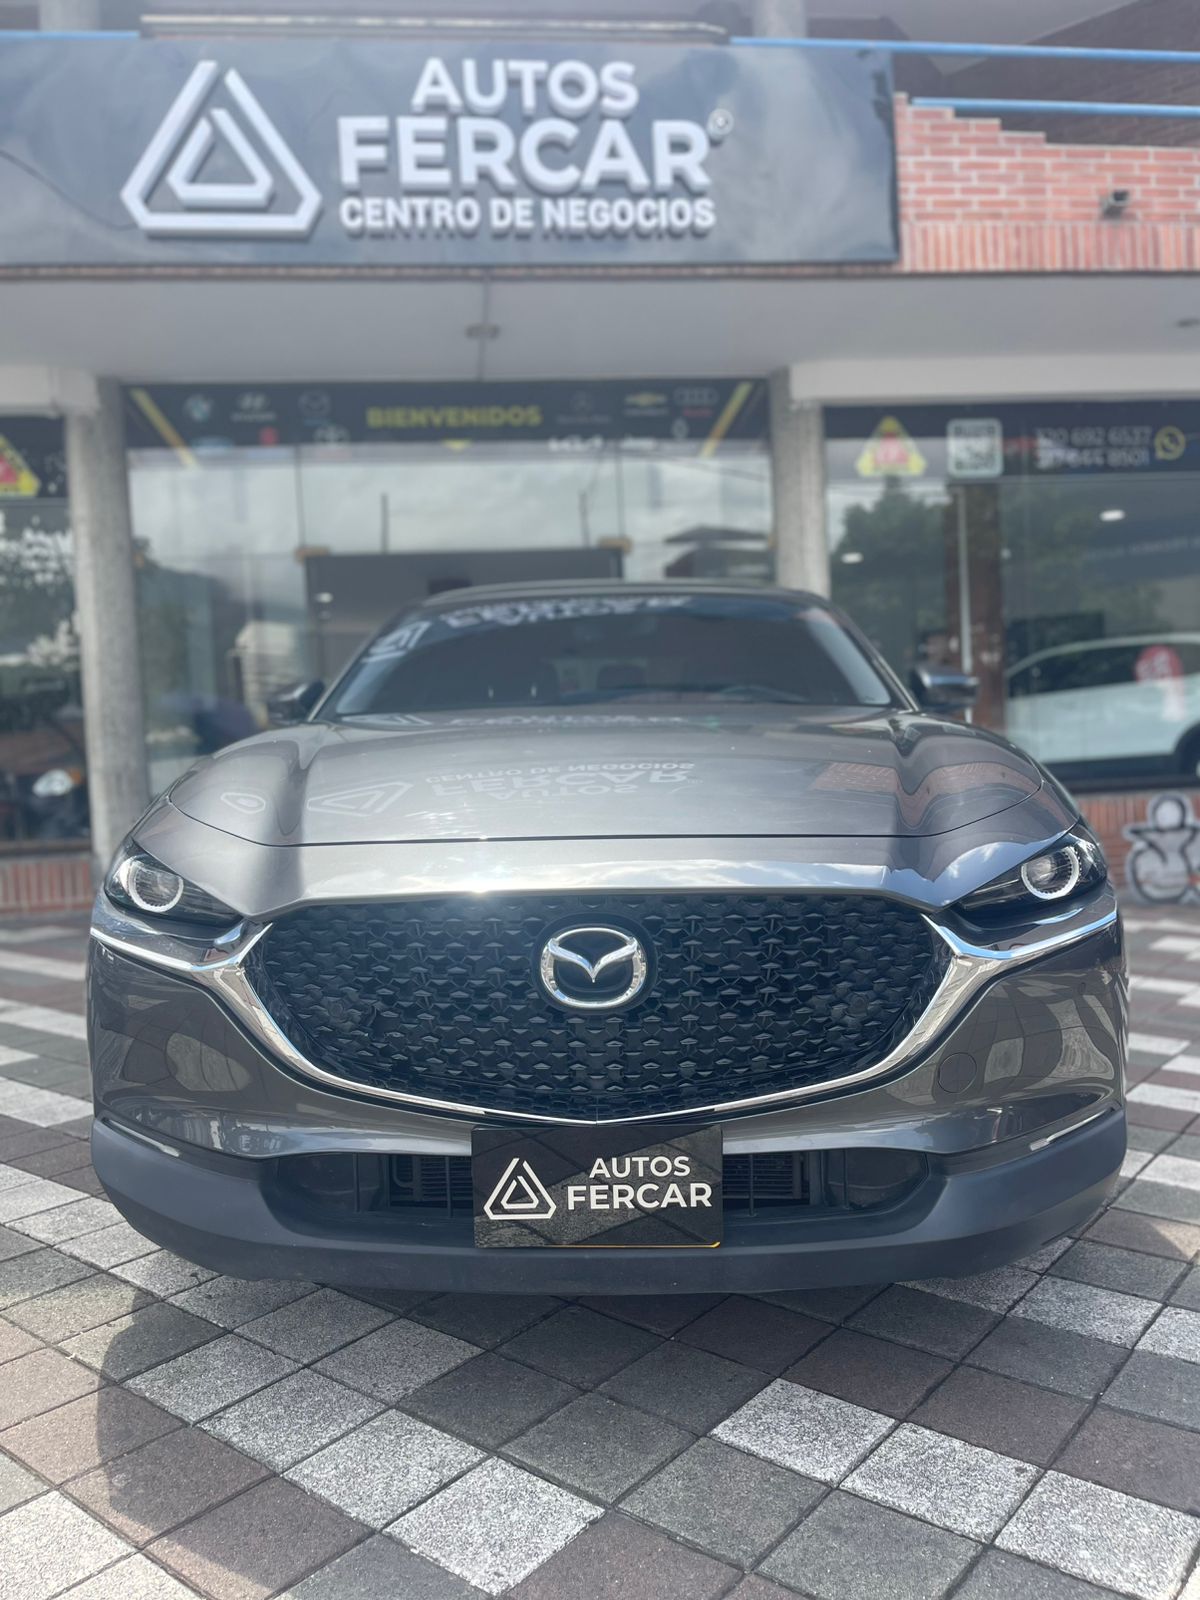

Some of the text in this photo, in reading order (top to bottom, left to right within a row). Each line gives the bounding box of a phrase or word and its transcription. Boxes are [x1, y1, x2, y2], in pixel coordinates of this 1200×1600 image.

[411, 57, 639, 114] AUTOS
[338, 116, 711, 193] FERCAR
[339, 196, 716, 231] CENTRO DE NEGOCIOS
[366, 405, 544, 429] BIENVENIDOS
[589, 1155, 691, 1179] AUTOS
[567, 1182, 712, 1210] FERCAR
